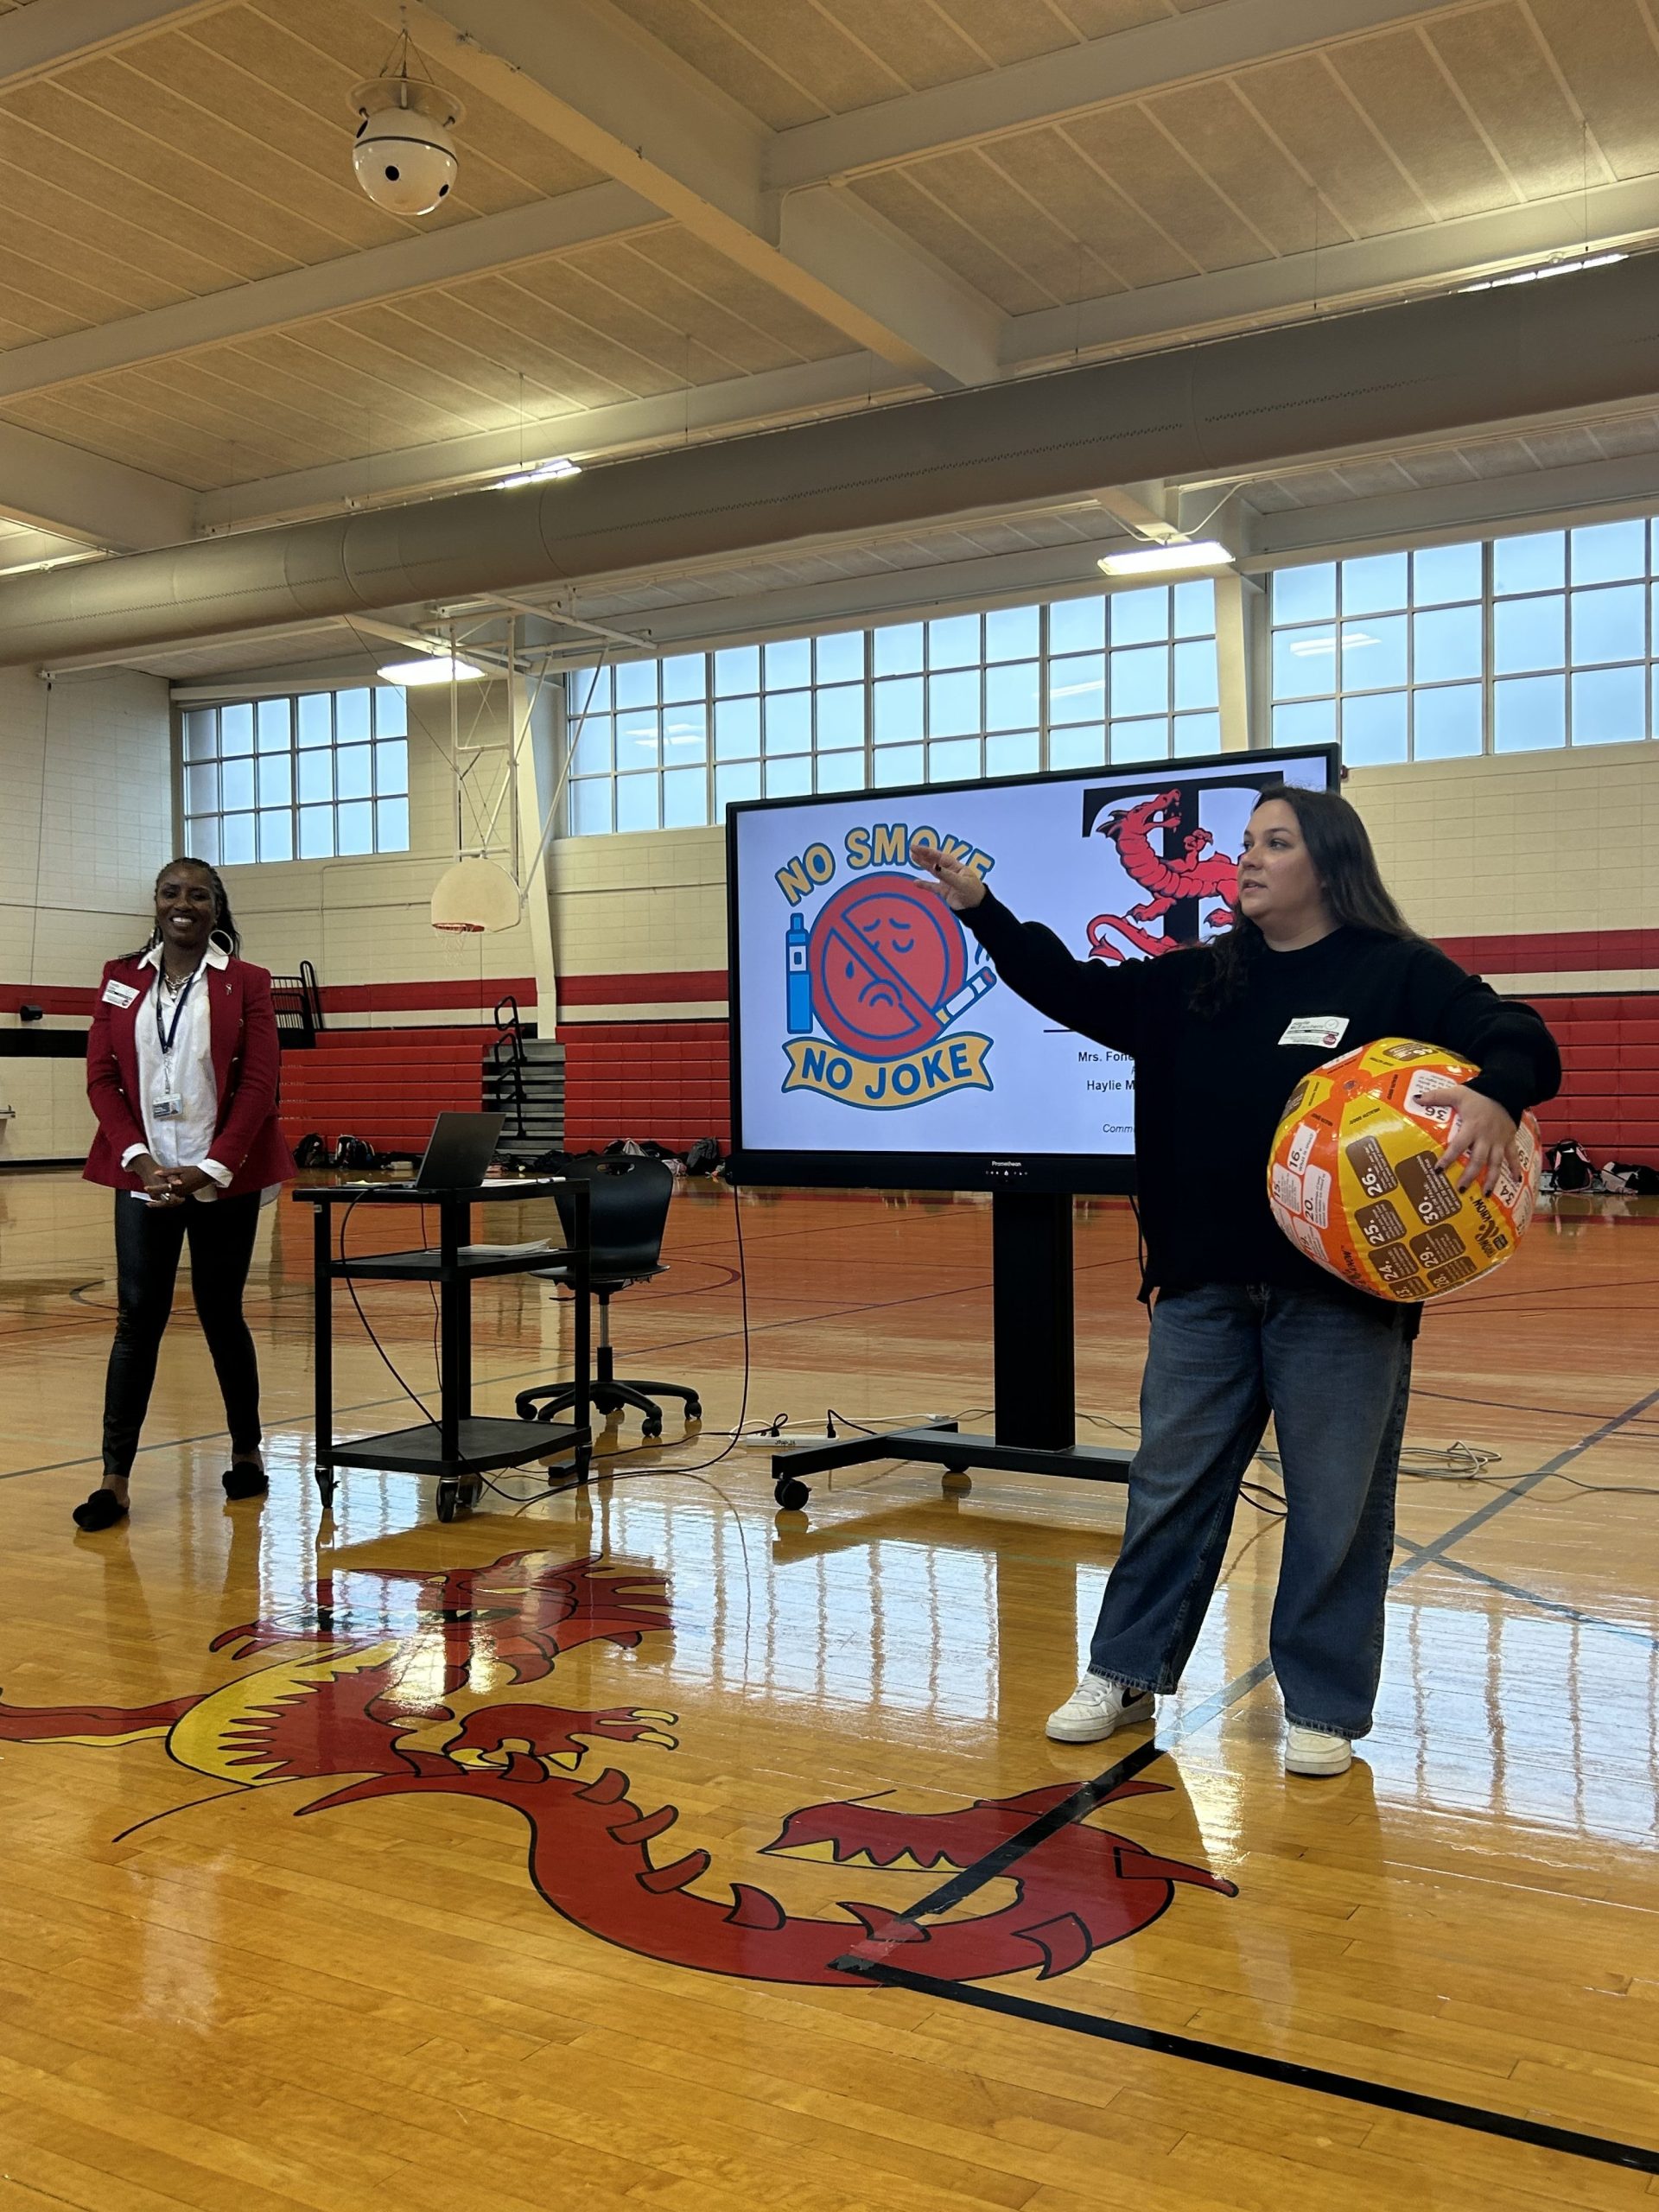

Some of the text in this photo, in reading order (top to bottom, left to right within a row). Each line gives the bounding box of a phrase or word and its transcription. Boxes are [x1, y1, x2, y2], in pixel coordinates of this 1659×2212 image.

[775, 842, 836, 906] NO
[1078, 1052, 1103, 1062] Mrs.
[802, 1042, 972, 1100] NO JOKE
[1087, 1080, 1135, 1092] Haylie M
[1103, 1124, 1134, 1133] Comm
[1289, 1148, 1301, 1167] 16.
[1362, 1167, 1382, 1196] 26.
[1305, 1198, 1313, 1220] 20.
[1418, 1196, 1439, 1224] 30.
[1363, 1219, 1385, 1244] 25.
[1420, 1247, 1439, 1268] 29.
[1378, 1261, 1399, 1281] 24.
